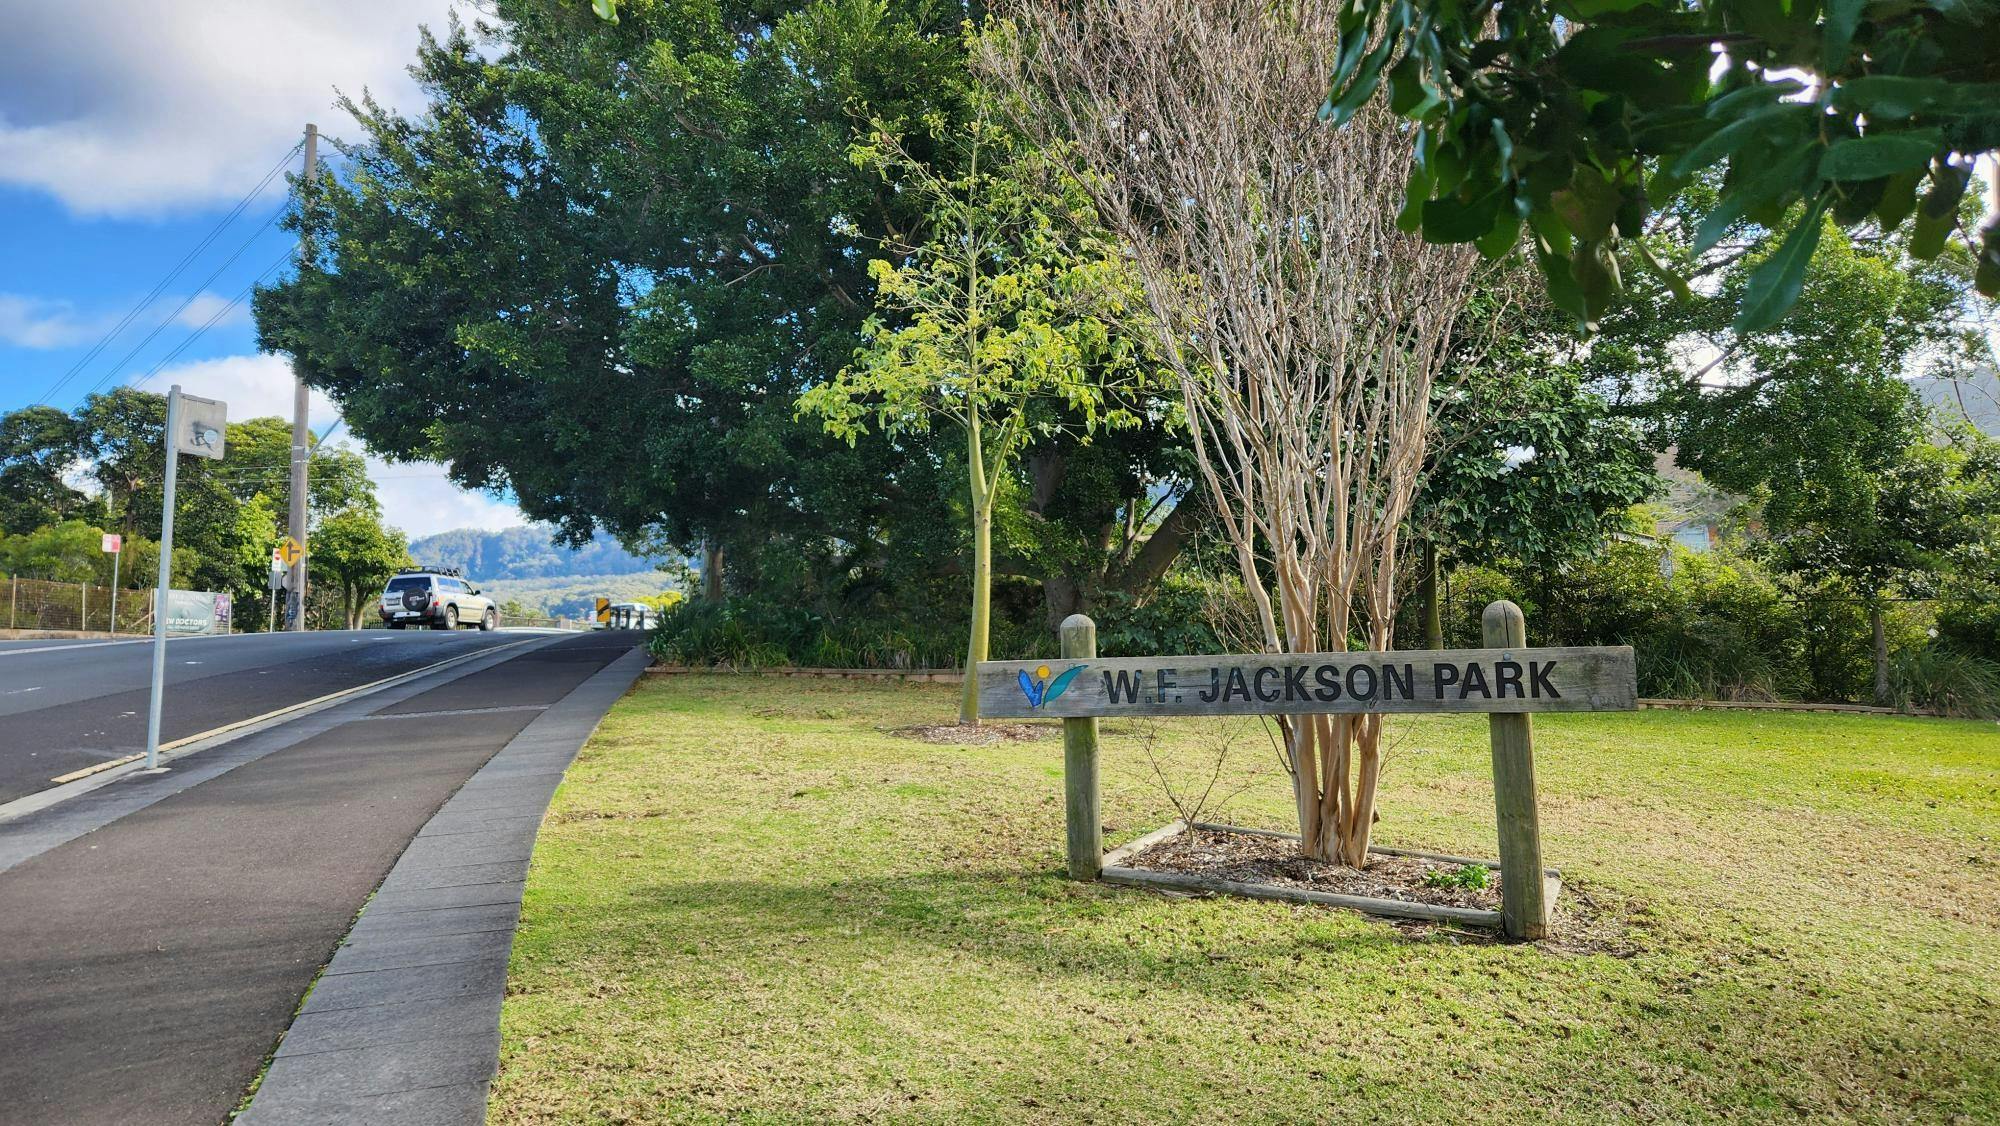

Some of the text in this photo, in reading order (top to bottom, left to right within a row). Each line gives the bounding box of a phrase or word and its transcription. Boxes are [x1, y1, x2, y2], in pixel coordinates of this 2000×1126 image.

[176, 618, 207, 626] DOCTORS
[1103, 660, 1562, 704] W.F. JACKSON PARK
